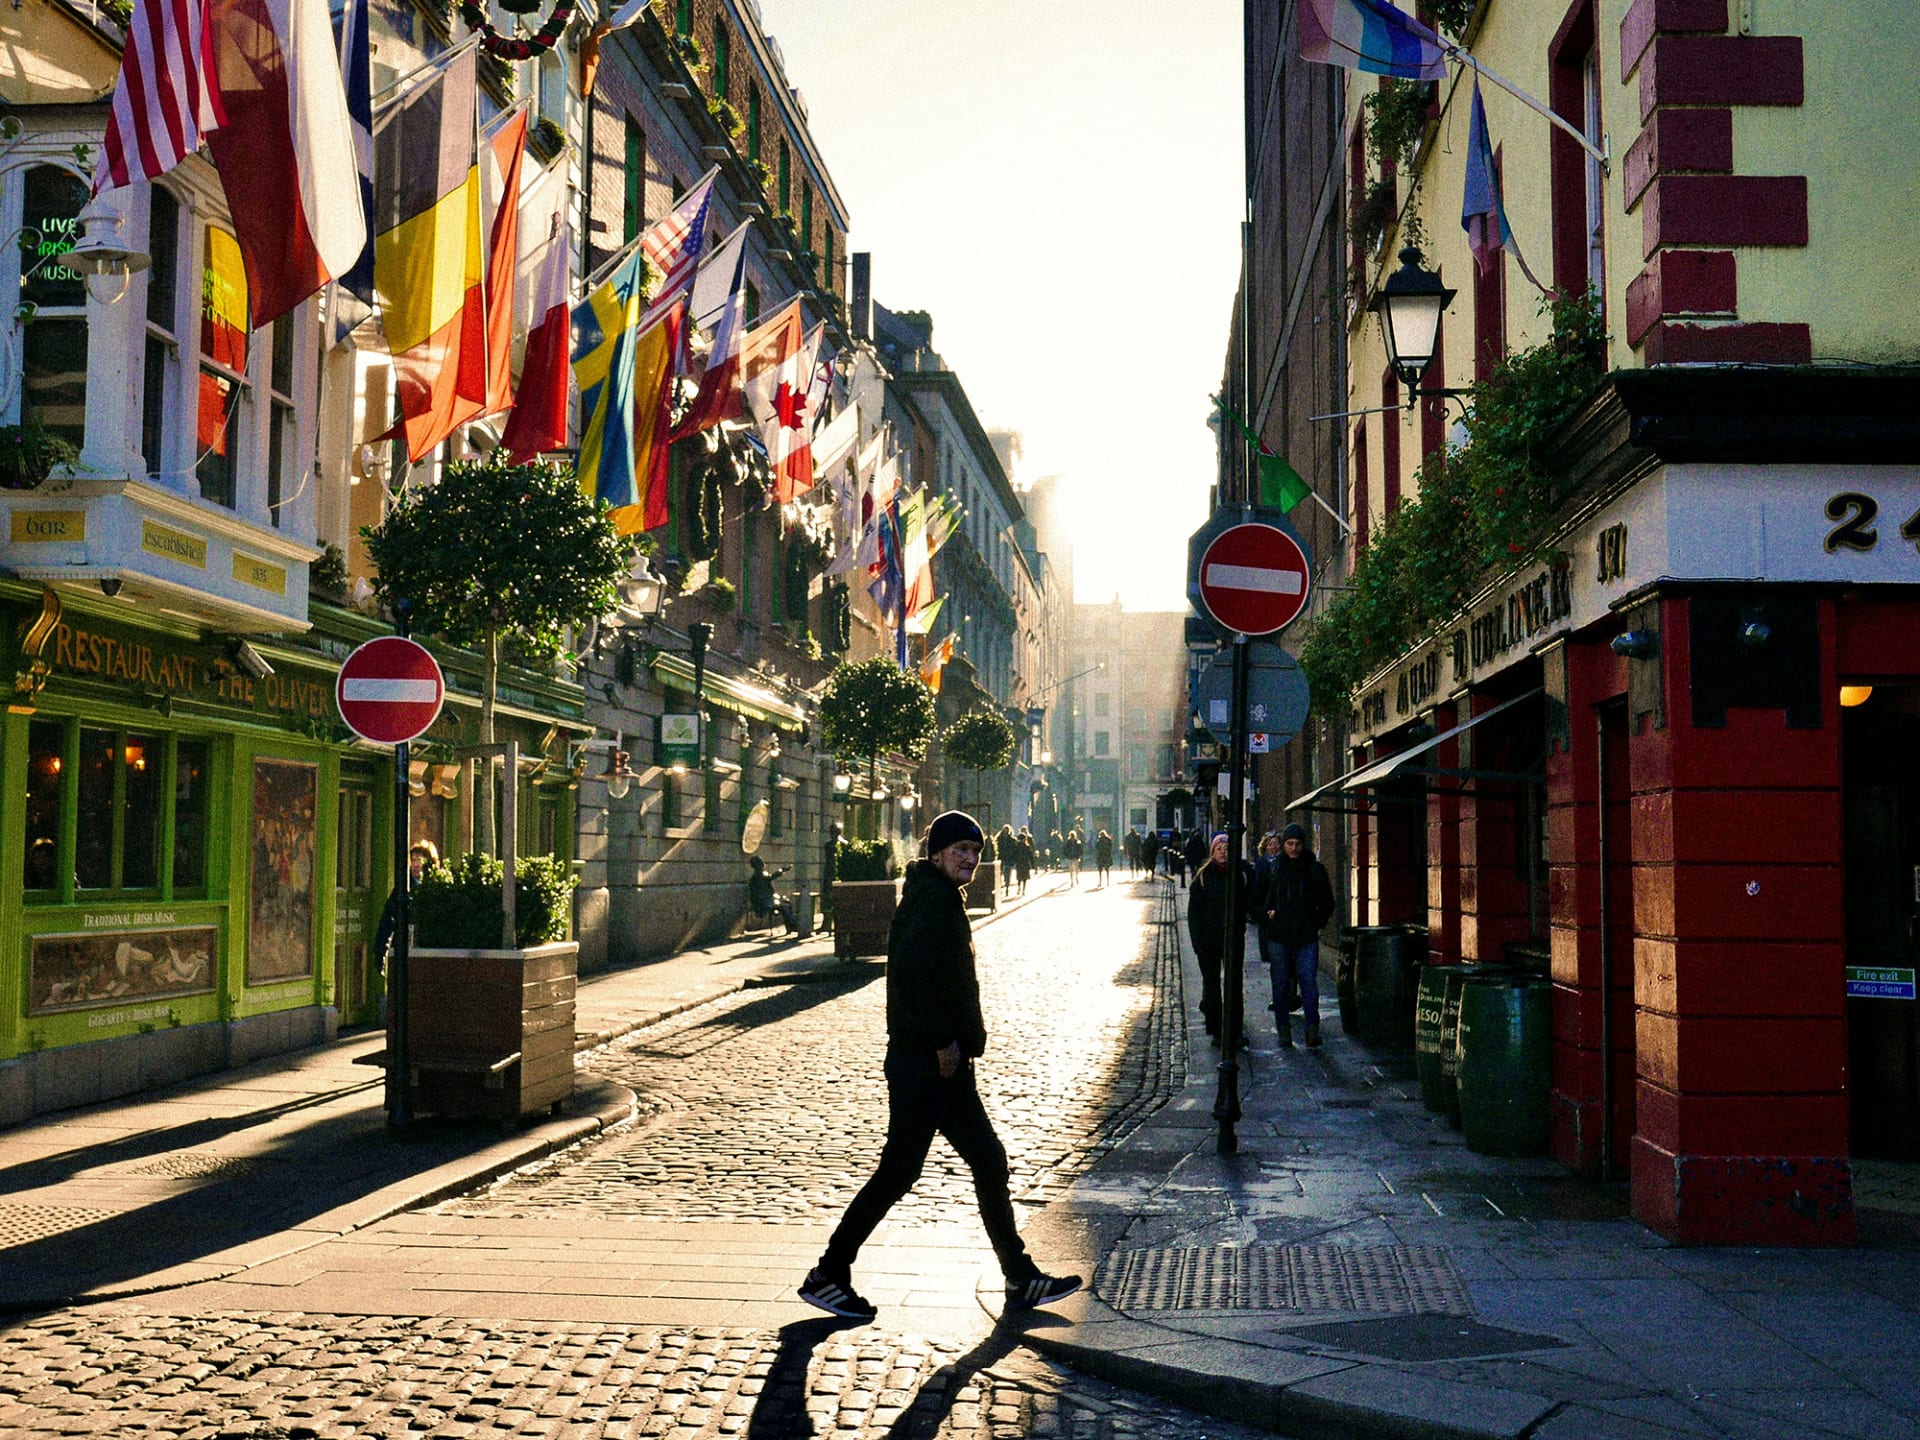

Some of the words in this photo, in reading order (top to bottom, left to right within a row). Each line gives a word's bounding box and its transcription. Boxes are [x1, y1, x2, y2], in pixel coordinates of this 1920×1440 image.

[42, 217, 77, 234] LIVE
[33, 264, 84, 281] MUSIC
[55, 623, 196, 692] RESTAURANT
[265, 675, 330, 716] OLIVER
[83, 913, 131, 928] TRADITIONAL
[133, 912, 153, 925] IRISH
[153, 911, 176, 924] MUSIC
[1856, 969, 1877, 980] Fire
[1879, 971, 1898, 981] exit
[1853, 983, 1877, 993] Keep
[1879, 985, 1903, 994] clear
